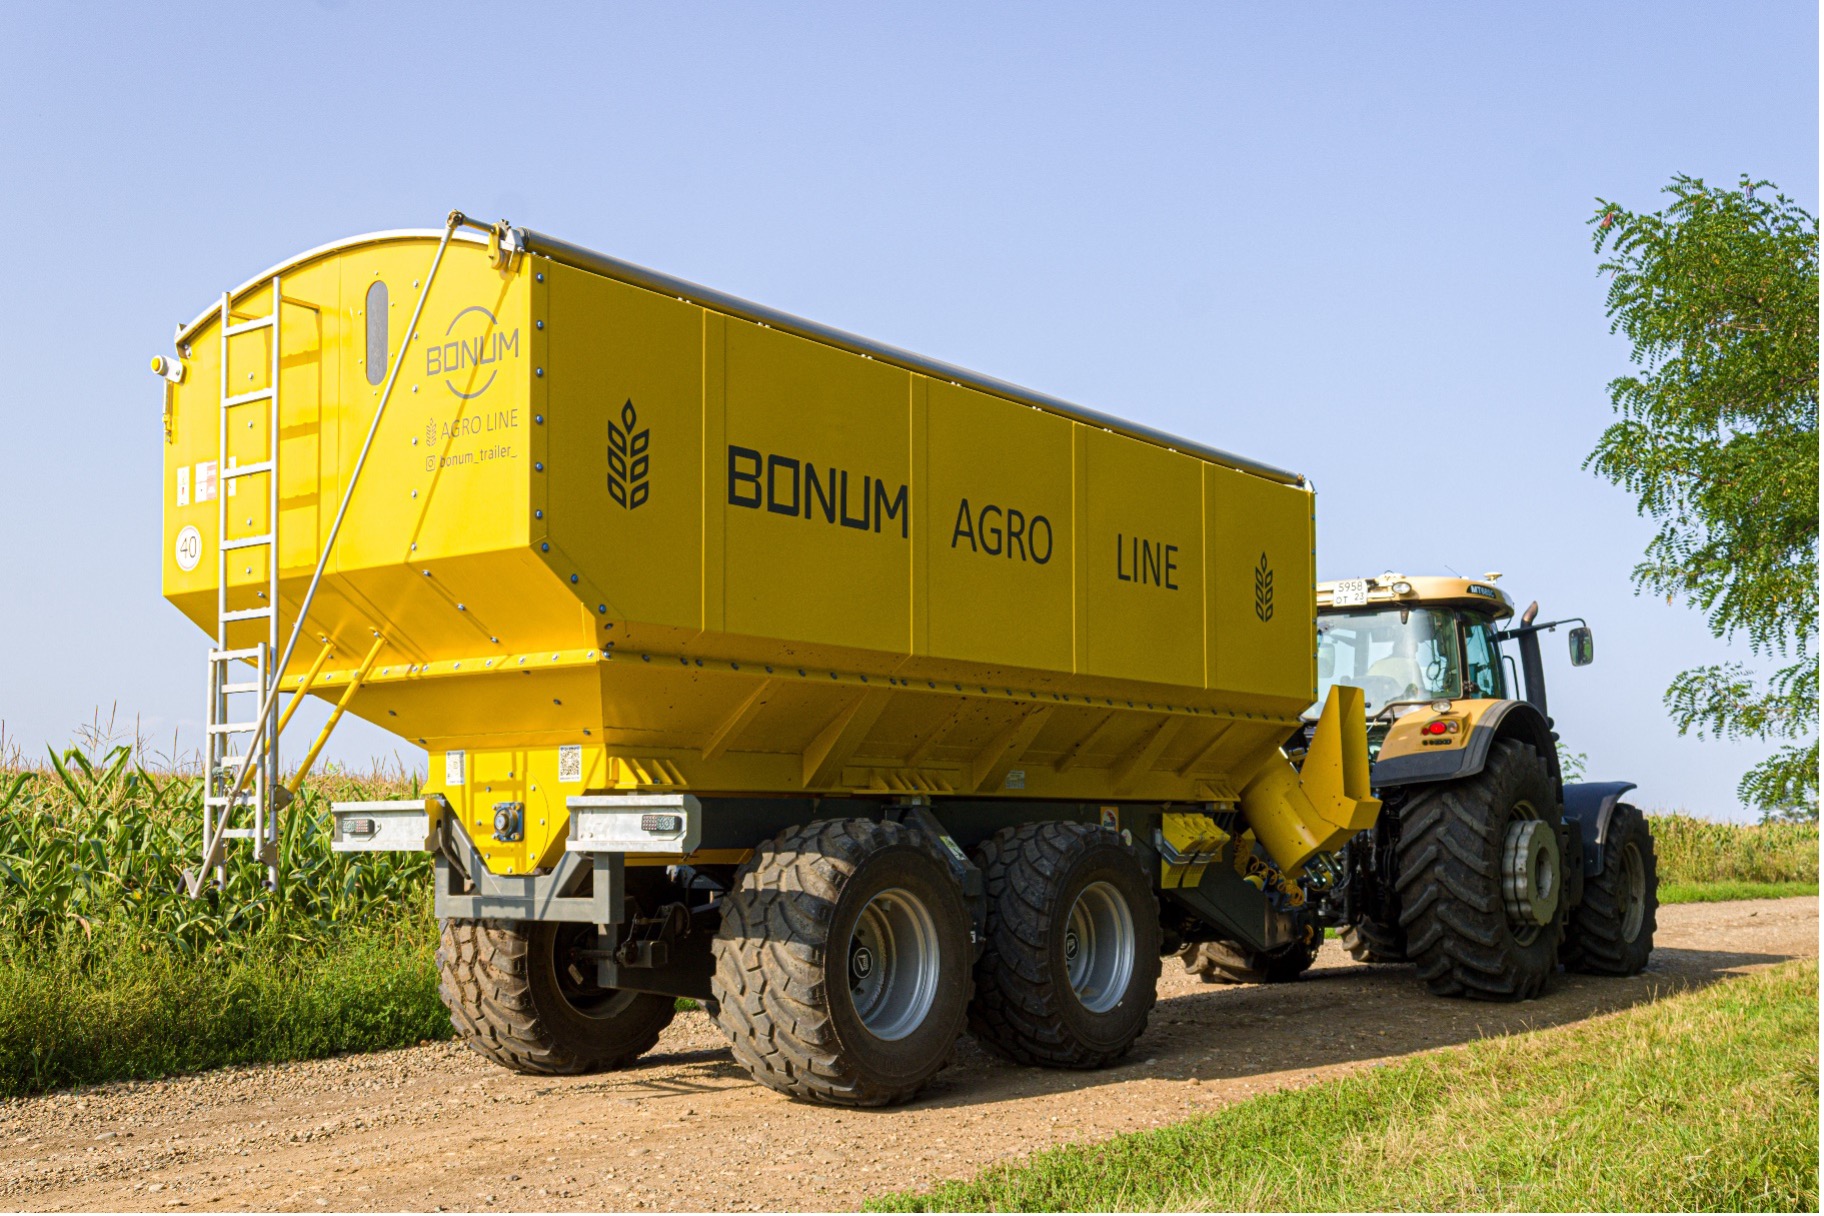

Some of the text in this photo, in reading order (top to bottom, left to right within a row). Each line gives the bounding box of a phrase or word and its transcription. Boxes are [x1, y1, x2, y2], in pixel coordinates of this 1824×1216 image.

[427, 328, 519, 376] BONUM
[441, 409, 518, 440] AGRO LINE
[440, 445, 518, 468] bonum_trailer_
[728, 444, 1179, 591] BONUM AGRO LINE
[180, 535, 197, 559] 40
[1338, 581, 1363, 592] 5958
